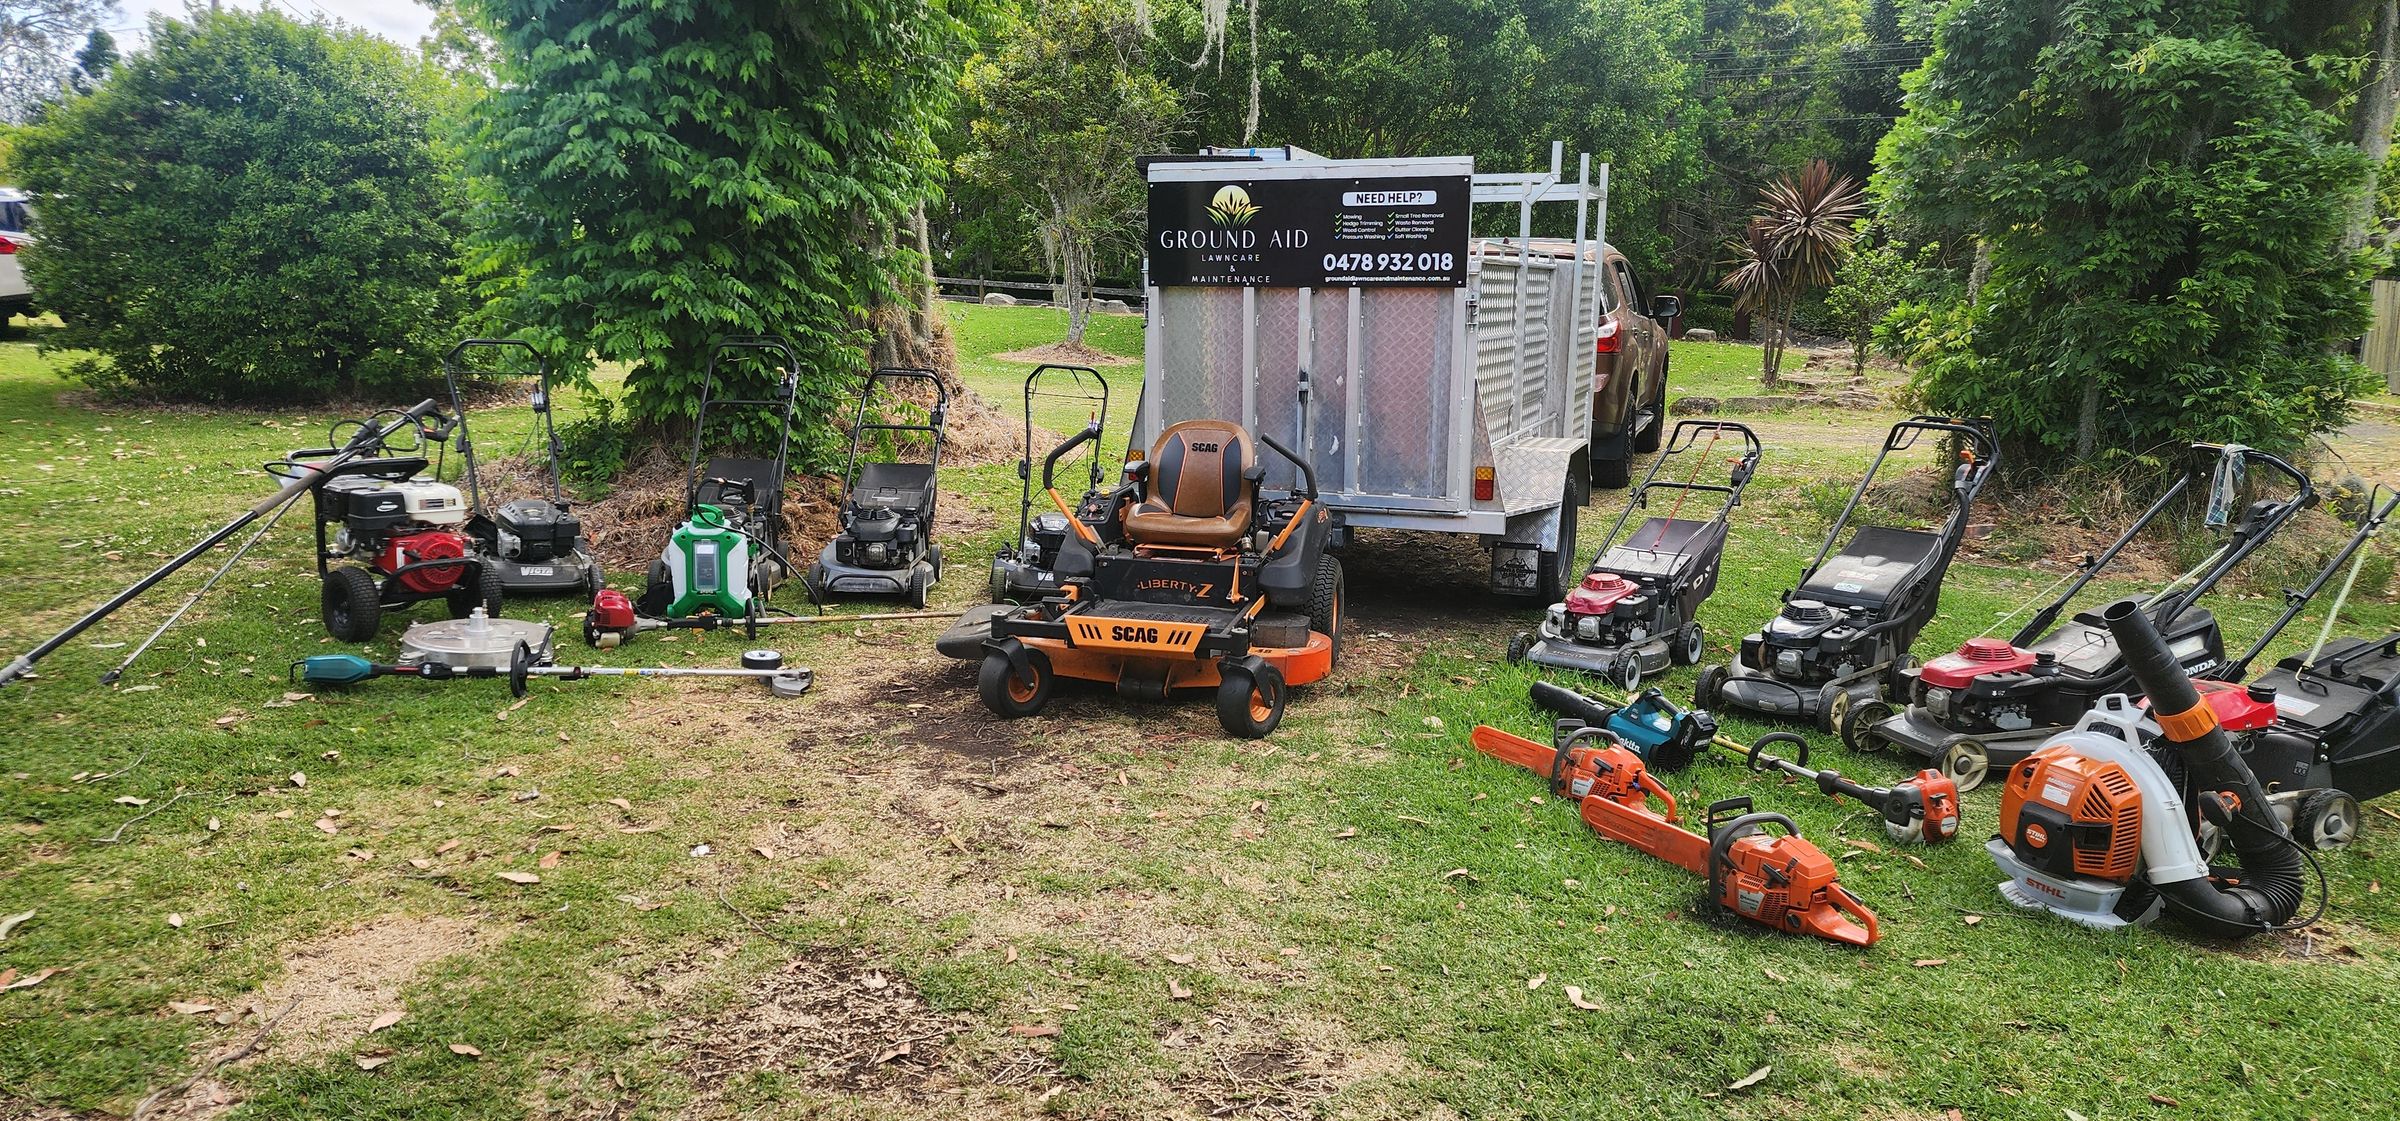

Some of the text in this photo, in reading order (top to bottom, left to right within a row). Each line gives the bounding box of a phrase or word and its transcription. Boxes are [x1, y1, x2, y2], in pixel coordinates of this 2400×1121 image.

[1356, 192, 1423, 204] NEED HELP?
[1160, 229, 1308, 249] GROUND AID
[1201, 254, 1260, 262] LAWNCARE
[1323, 253, 1453, 271] 0478 932 018
[1191, 275, 1271, 283] MAINTENANCE
[1191, 443, 1218, 453] SCAG
[521, 567, 553, 576] VICTA
[1139, 579, 1213, 598] LIBERTY Z
[1112, 625, 1158, 643] SCAG
[2183, 659, 2217, 676] ONDA
[1619, 737, 1641, 754] akita
[2026, 828, 2047, 840] STIHL
[2026, 877, 2066, 900] STIHL
